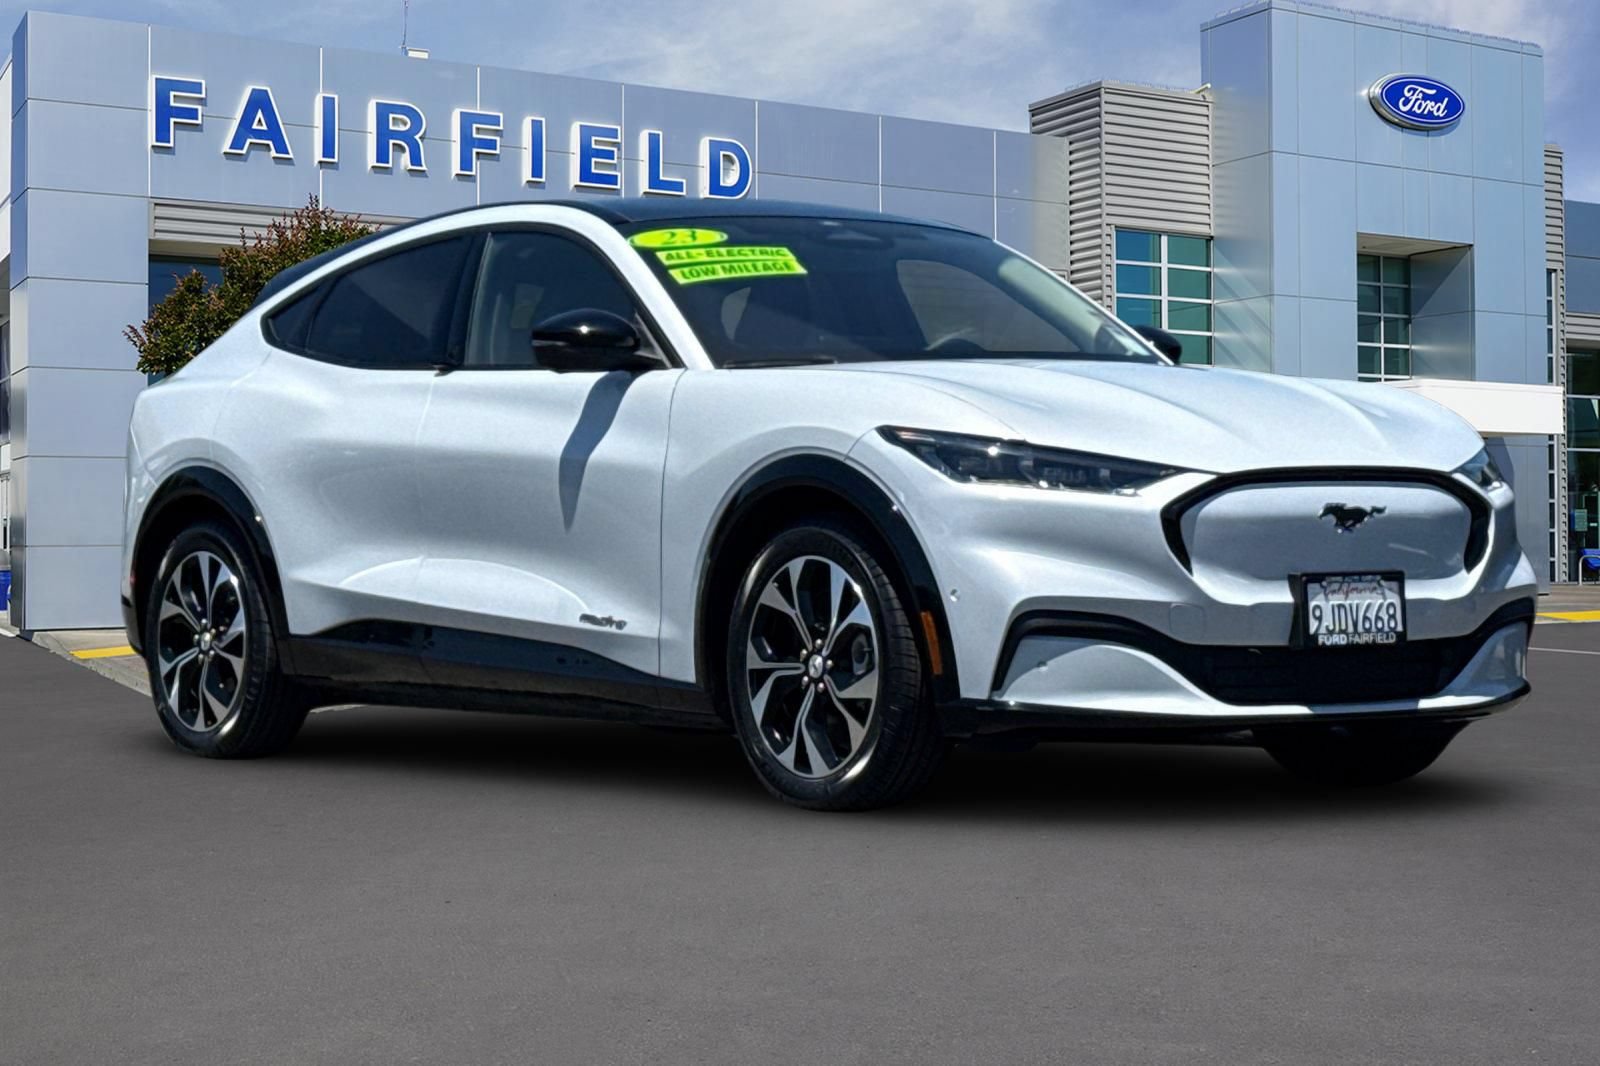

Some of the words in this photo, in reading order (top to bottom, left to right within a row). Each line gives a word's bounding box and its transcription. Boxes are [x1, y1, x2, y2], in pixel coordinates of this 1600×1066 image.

[1398, 84, 1449, 117] Ford
[151, 75, 752, 199] FAIRFIELD
[661, 230, 697, 245] 23
[665, 248, 788, 261] ALL-ELECTRIC
[680, 266, 716, 280] LOW
[721, 261, 793, 275] MILEAGE
[1311, 602, 1397, 633] 9JDV668
[1318, 633, 1348, 646] FORD
[1348, 632, 1397, 644] FAIRFIELD
